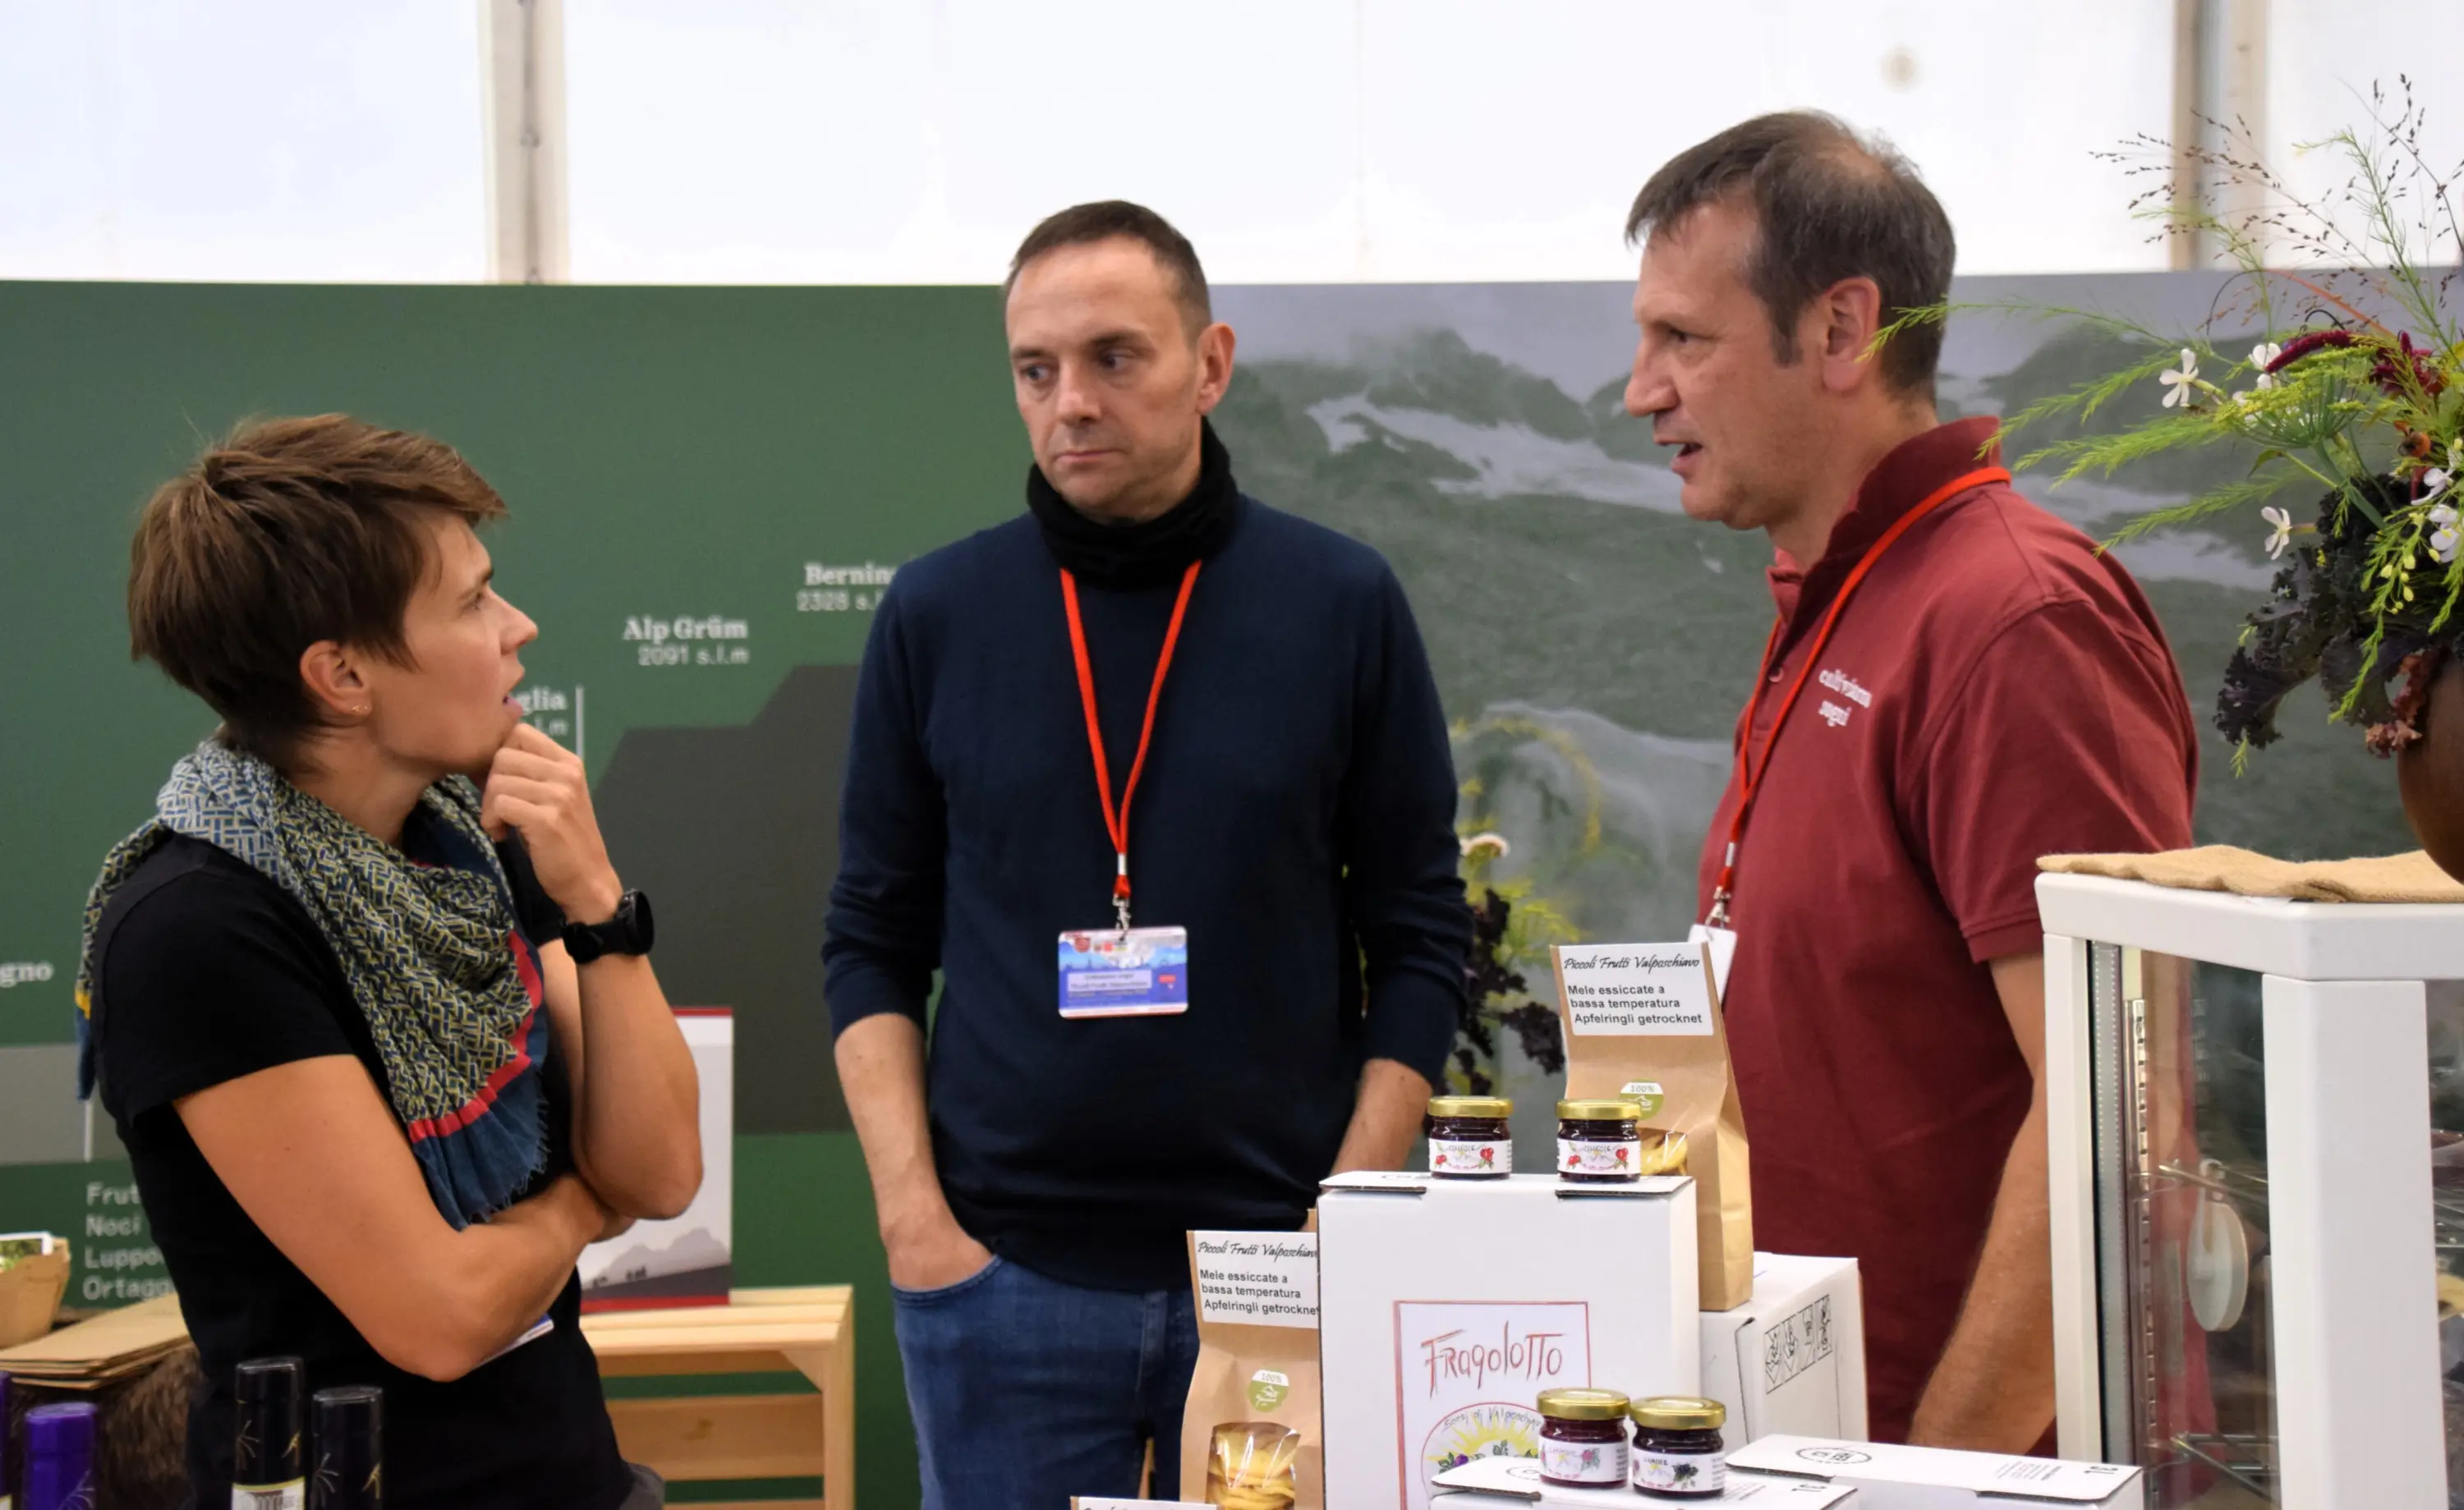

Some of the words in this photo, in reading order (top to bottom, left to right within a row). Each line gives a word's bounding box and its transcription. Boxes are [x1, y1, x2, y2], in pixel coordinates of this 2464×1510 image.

[804, 561, 895, 585] Bernin
[623, 616, 669, 645] Alp
[673, 615, 748, 639] Grüm
[638, 644, 688, 666] 2091
[0, 962, 54, 988] gno
[1564, 955, 1597, 970] Piccoli
[1600, 956, 1630, 970] Frutti
[1634, 953, 1700, 975] Valposchiavo
[1568, 985, 1595, 995] Mele
[1598, 985, 1654, 995] essiccate
[1659, 985, 1665, 994] a
[1570, 998, 1605, 1008] bassa
[1608, 998, 1680, 1010] temperatura
[1574, 1012, 1634, 1026] Apfelringli
[1638, 1013, 1703, 1026] getrocknet
[86, 1182, 140, 1206] Frut
[85, 1214, 140, 1237] Noci
[85, 1246, 164, 1272] Luppo
[1198, 1241, 1229, 1254] Piccoli
[1230, 1243, 1258, 1255] Frutti
[1200, 1269, 1225, 1280] Mele
[1228, 1272, 1279, 1283] essiccate
[1202, 1283, 1232, 1295] bassa
[1235, 1286, 1301, 1299] temperatura
[1204, 1299, 1259, 1314] Apfelringli
